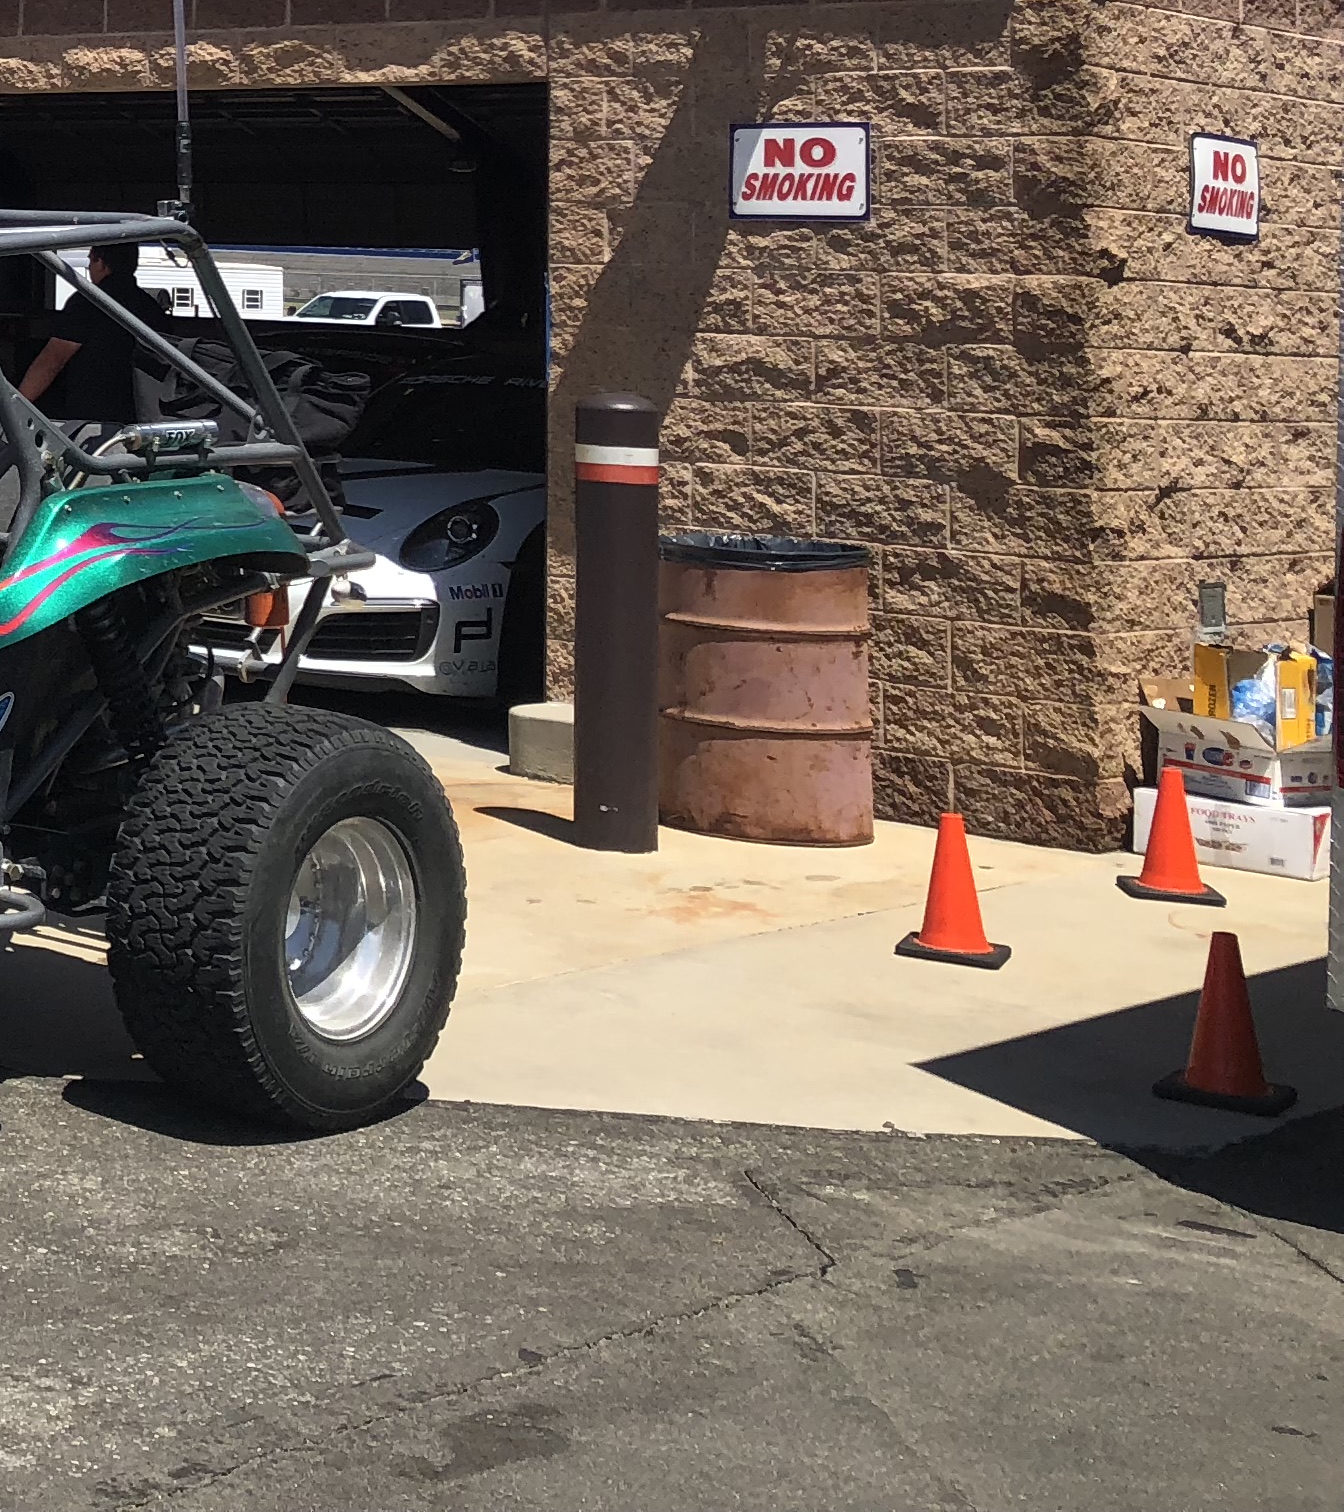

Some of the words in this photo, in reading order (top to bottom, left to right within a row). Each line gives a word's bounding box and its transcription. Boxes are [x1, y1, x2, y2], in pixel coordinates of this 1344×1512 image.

[763, 137, 836, 168] NO
[1212, 150, 1247, 184] NO
[741, 170, 857, 203] SMOKING
[1198, 182, 1254, 220] SMOKING
[166, 429, 195, 445] FOX
[448, 584, 490, 601] Mobil
[1190, 807, 1218, 819] FOOD
[1221, 811, 1256, 823] TRAYS
